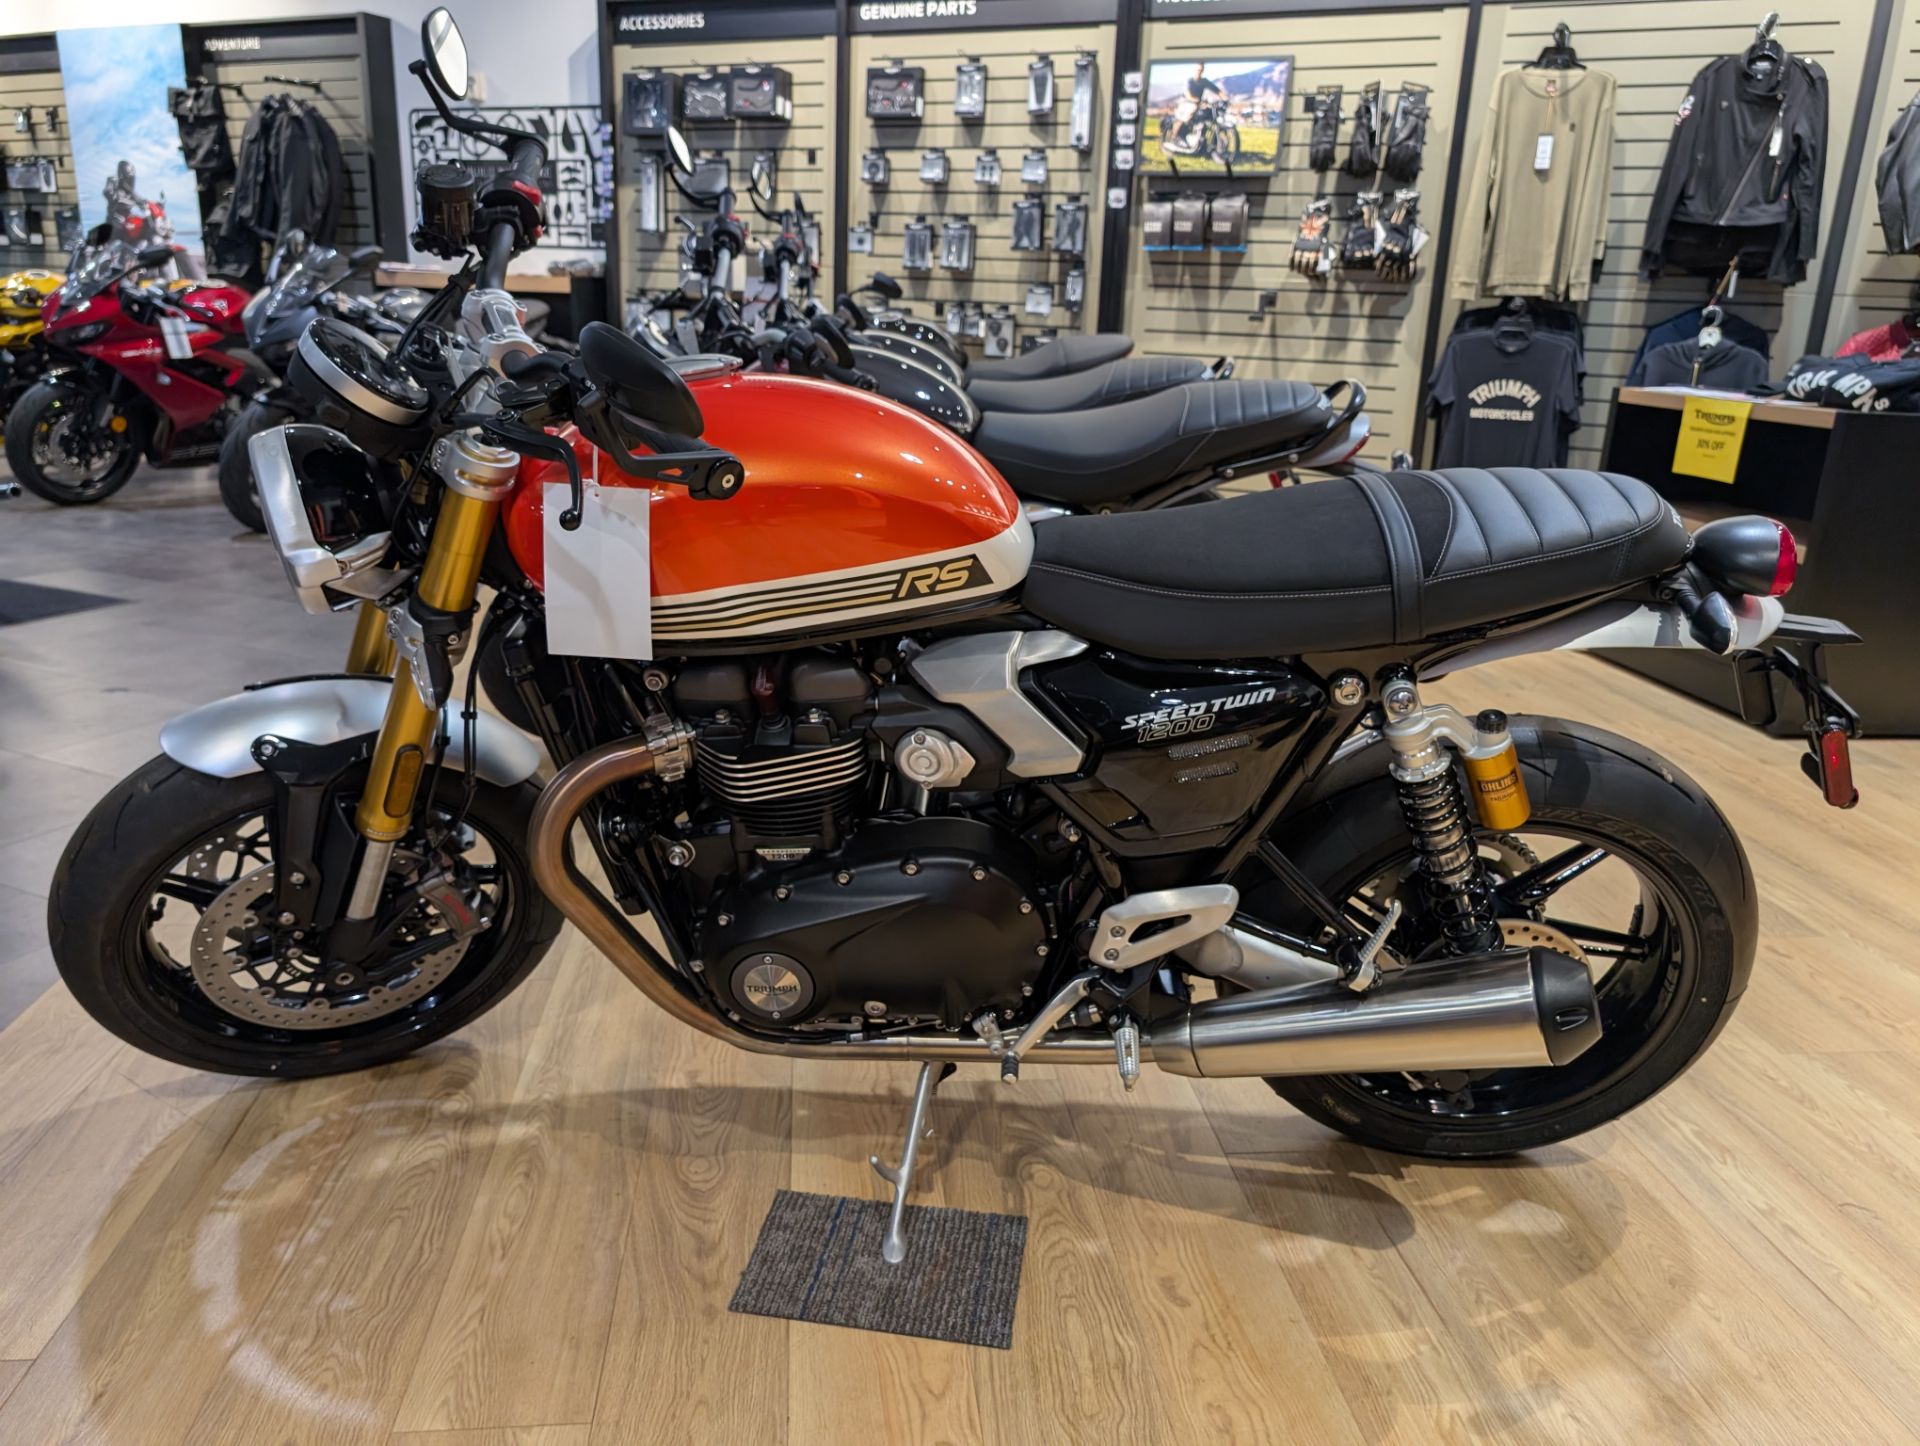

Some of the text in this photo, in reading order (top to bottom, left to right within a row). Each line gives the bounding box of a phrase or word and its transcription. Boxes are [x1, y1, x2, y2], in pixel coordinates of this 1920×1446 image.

[620, 12, 705, 31] ACCESSORIES
[860, 0, 977, 20] GENUINE PARTS
[1467, 378, 1542, 408] TRIUMPH
[1469, 406, 1534, 421] MOTORCYCLES
[898, 558, 973, 598] RS
[1121, 687, 1277, 730] SPEED TWIN
[1137, 713, 1216, 743] 1200
[746, 984, 798, 996] TRIUMPH
